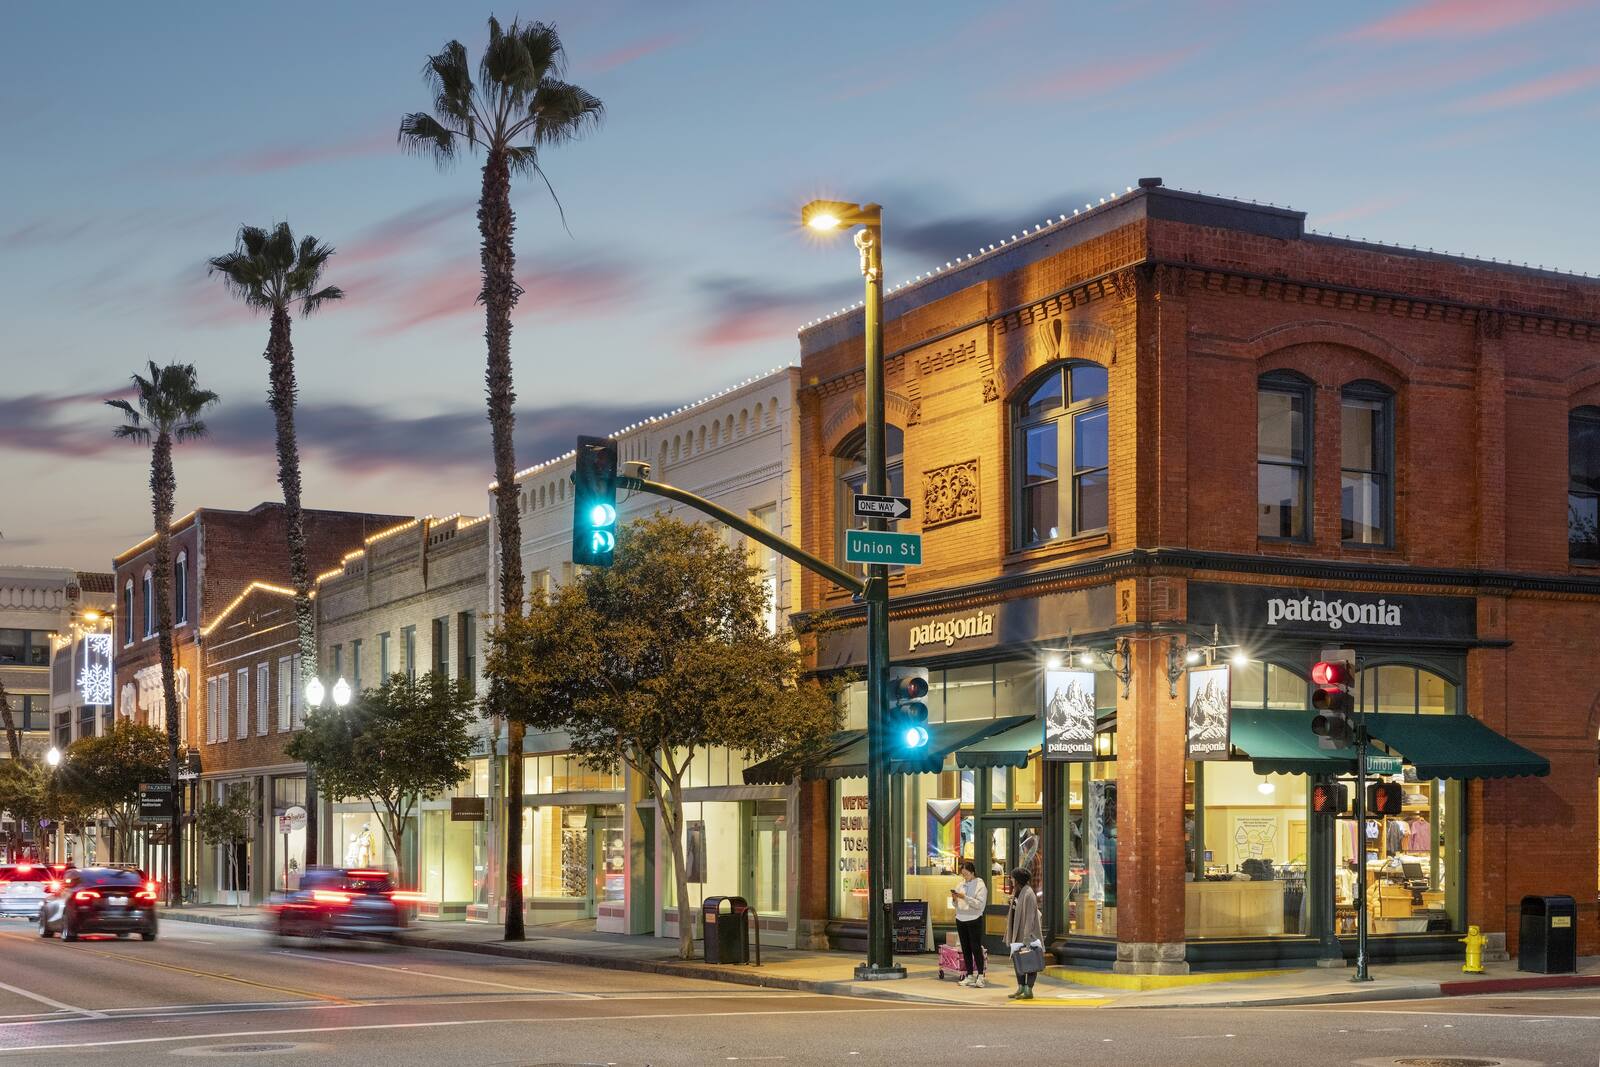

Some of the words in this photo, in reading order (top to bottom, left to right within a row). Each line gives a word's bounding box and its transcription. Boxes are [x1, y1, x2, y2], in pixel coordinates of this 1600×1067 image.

[860, 502, 876, 511] ONE
[877, 503, 895, 512] WAY
[853, 539, 893, 555] Union
[900, 542, 916, 556] St
[1267, 595, 1402, 630] patagonia
[908, 610, 993, 651] patagonia
[1048, 742, 1093, 754] patagonia
[1189, 741, 1226, 754] patagonia
[1366, 756, 1393, 771] Union
[842, 795, 869, 810] WE'RE
[843, 837, 855, 851] TO
[856, 838, 869, 851] SA
